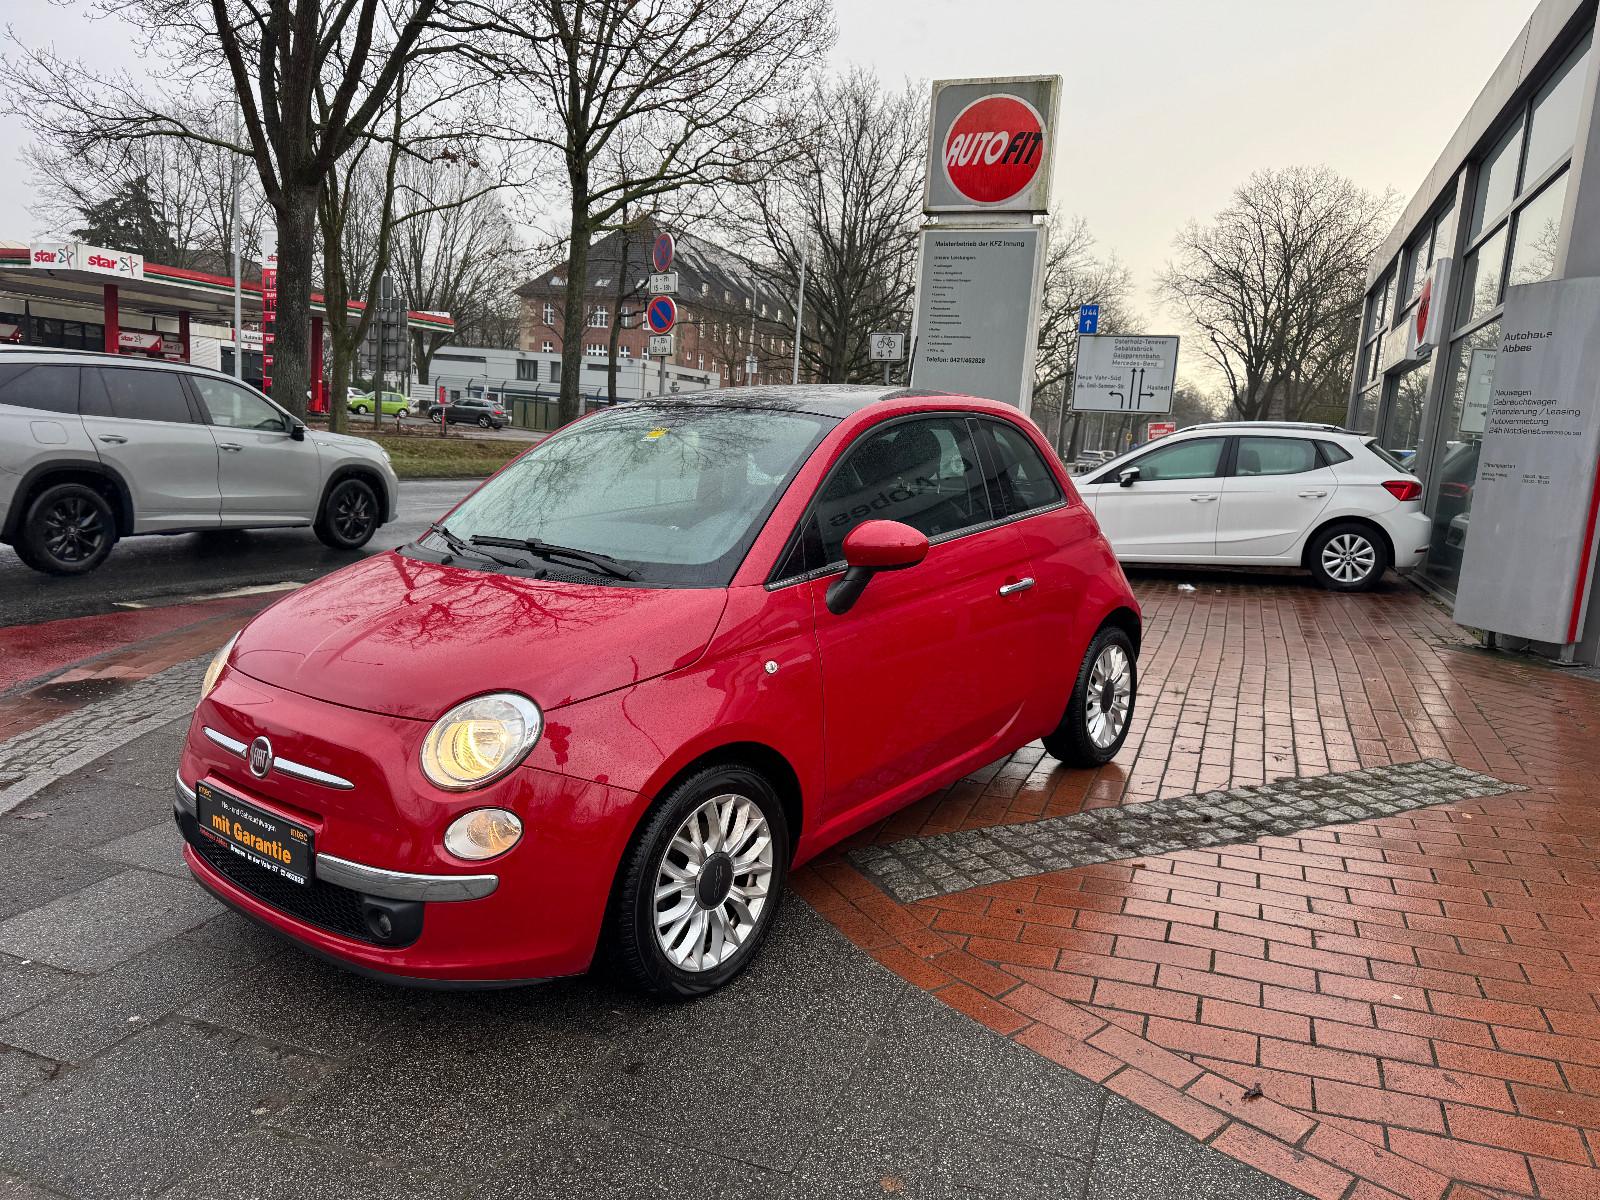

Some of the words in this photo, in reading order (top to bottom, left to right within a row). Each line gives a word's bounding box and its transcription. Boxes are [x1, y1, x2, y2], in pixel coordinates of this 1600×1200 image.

[946, 131, 1043, 167] AUTOFIT
[1003, 240, 1025, 248] Innung
[34, 249, 57, 263] star
[87, 254, 118, 269] star
[1504, 331, 1553, 341] Autohaus
[1502, 343, 1533, 353] Abbes
[1493, 399, 1557, 407] Gebrauchtwagen
[1491, 408, 1538, 417] Finanzierung
[1546, 408, 1581, 418] Leasing
[1490, 418, 1549, 426] Autovermietung
[1503, 427, 1541, 435] Notdienst
[212, 814, 231, 836] mit
[233, 822, 292, 864] Garantie
[290, 828, 308, 842] intec
